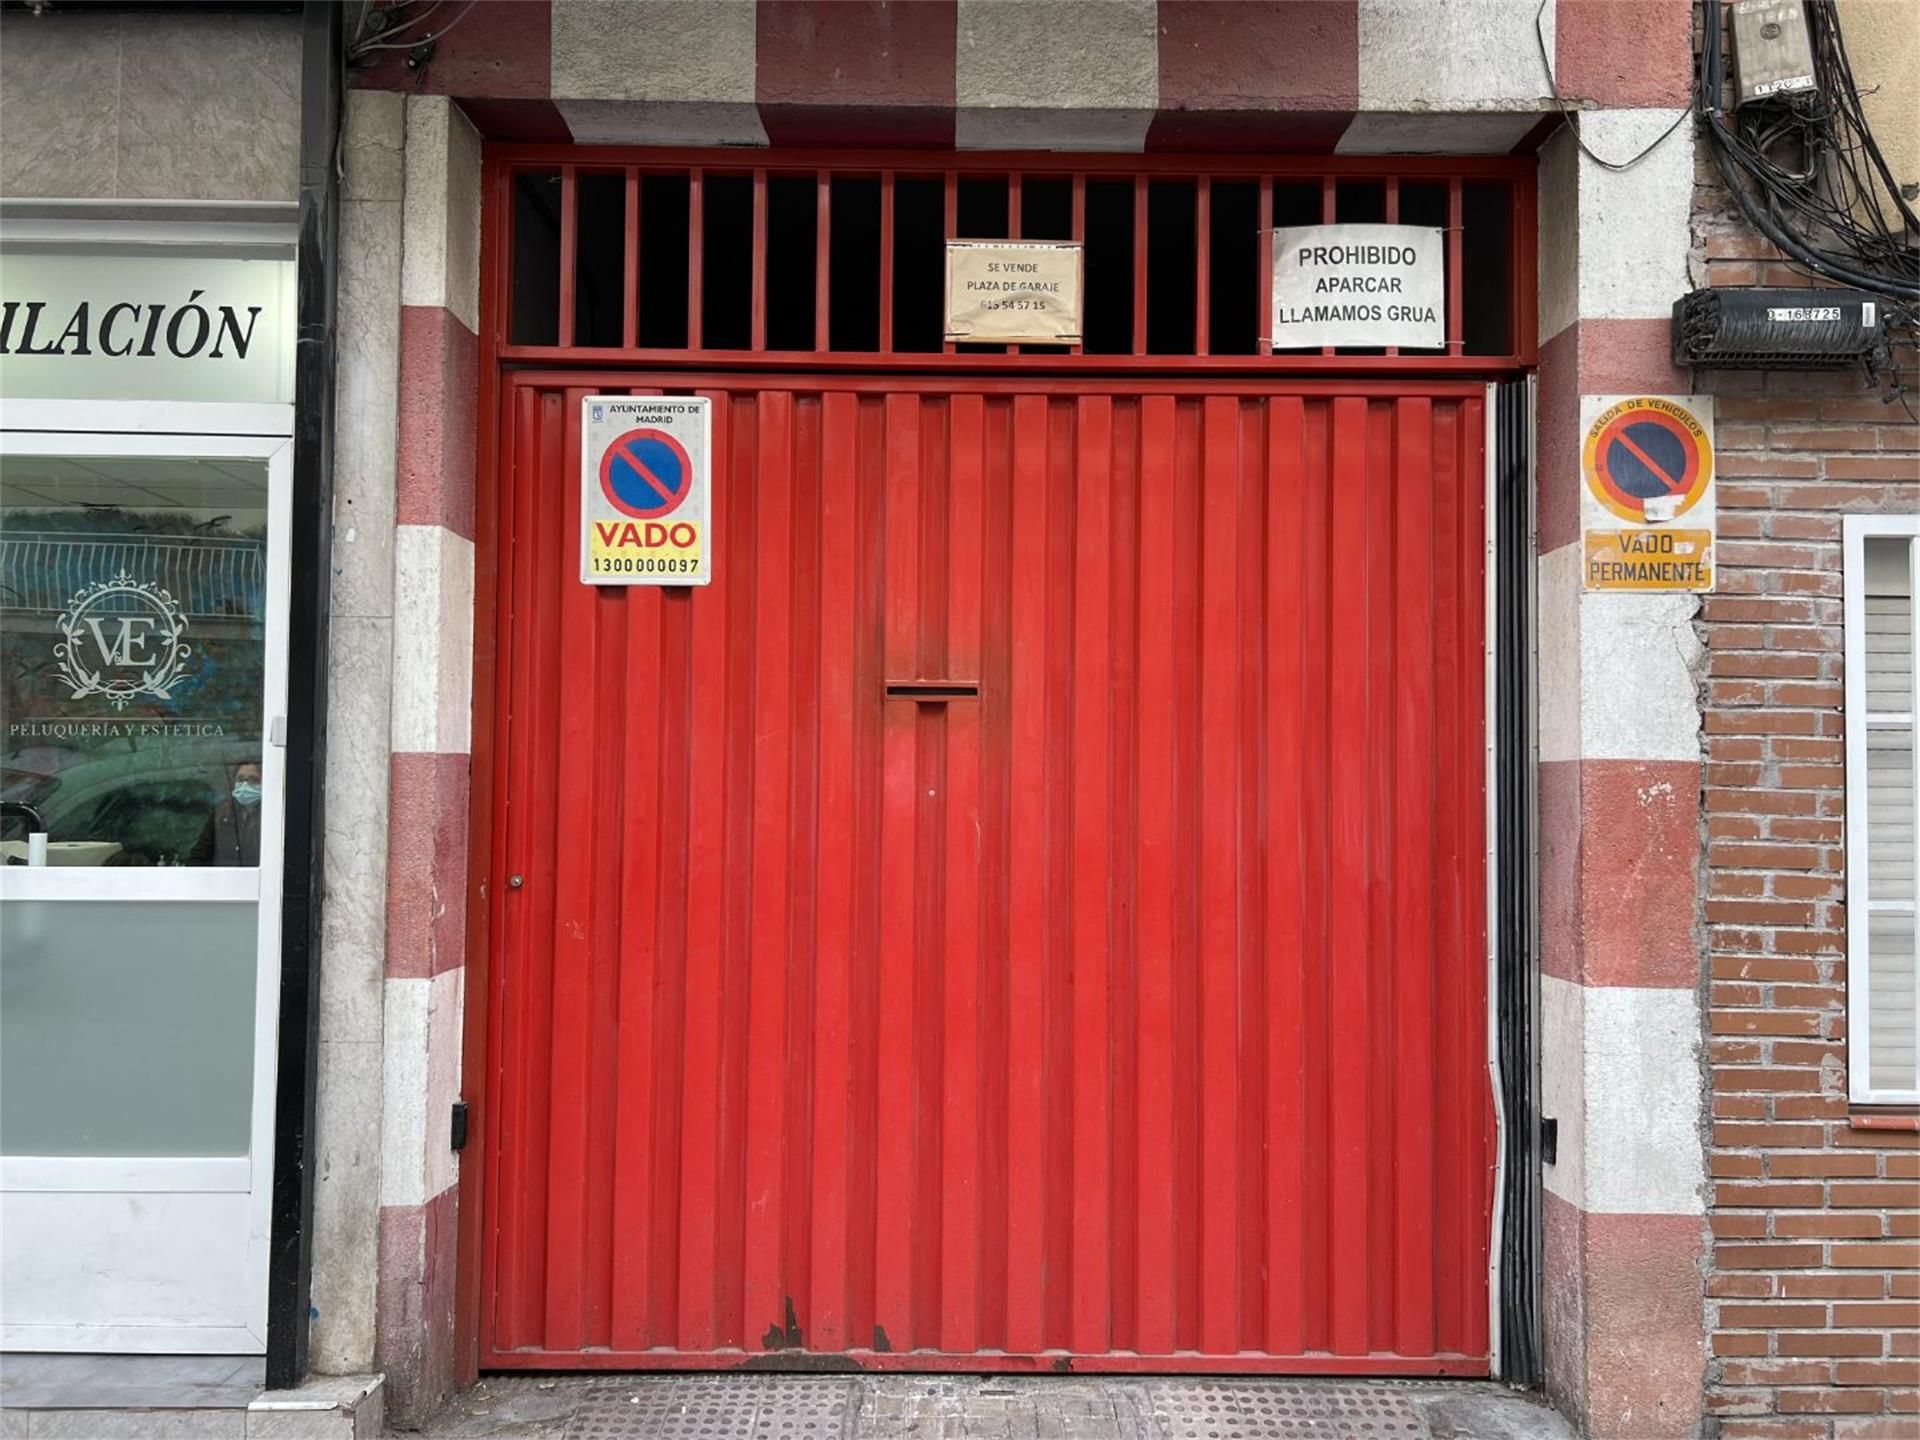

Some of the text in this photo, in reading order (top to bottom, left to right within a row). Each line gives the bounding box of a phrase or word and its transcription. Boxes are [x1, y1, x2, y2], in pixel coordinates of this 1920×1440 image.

[1299, 246, 1416, 267] PROHIBIDO
[987, 263, 1038, 273] SE VENDE
[967, 281, 1059, 292] PLAZA DE GARAJE
[1315, 277, 1402, 293] APARCAR
[1002, 301, 1014, 310] 54
[1017, 301, 1030, 310] 57
[1033, 301, 1046, 310] 15
[1279, 305, 1436, 323] LLAMAMOS GRUA
[0, 290, 262, 359] ILACIÓN
[609, 405, 699, 414] AYUNTAMIENTO DE
[635, 415, 673, 424] MADRID
[1590, 399, 1702, 438] SALIDA DE VEHICULOS
[595, 522, 697, 548] VADO
[1618, 534, 1673, 553] VADO
[594, 558, 698, 572] 1300000097
[1590, 562, 1705, 581] PERMANENTE
[10, 723, 120, 739] PELUQUERÍA
[125, 724, 134, 736] Y
